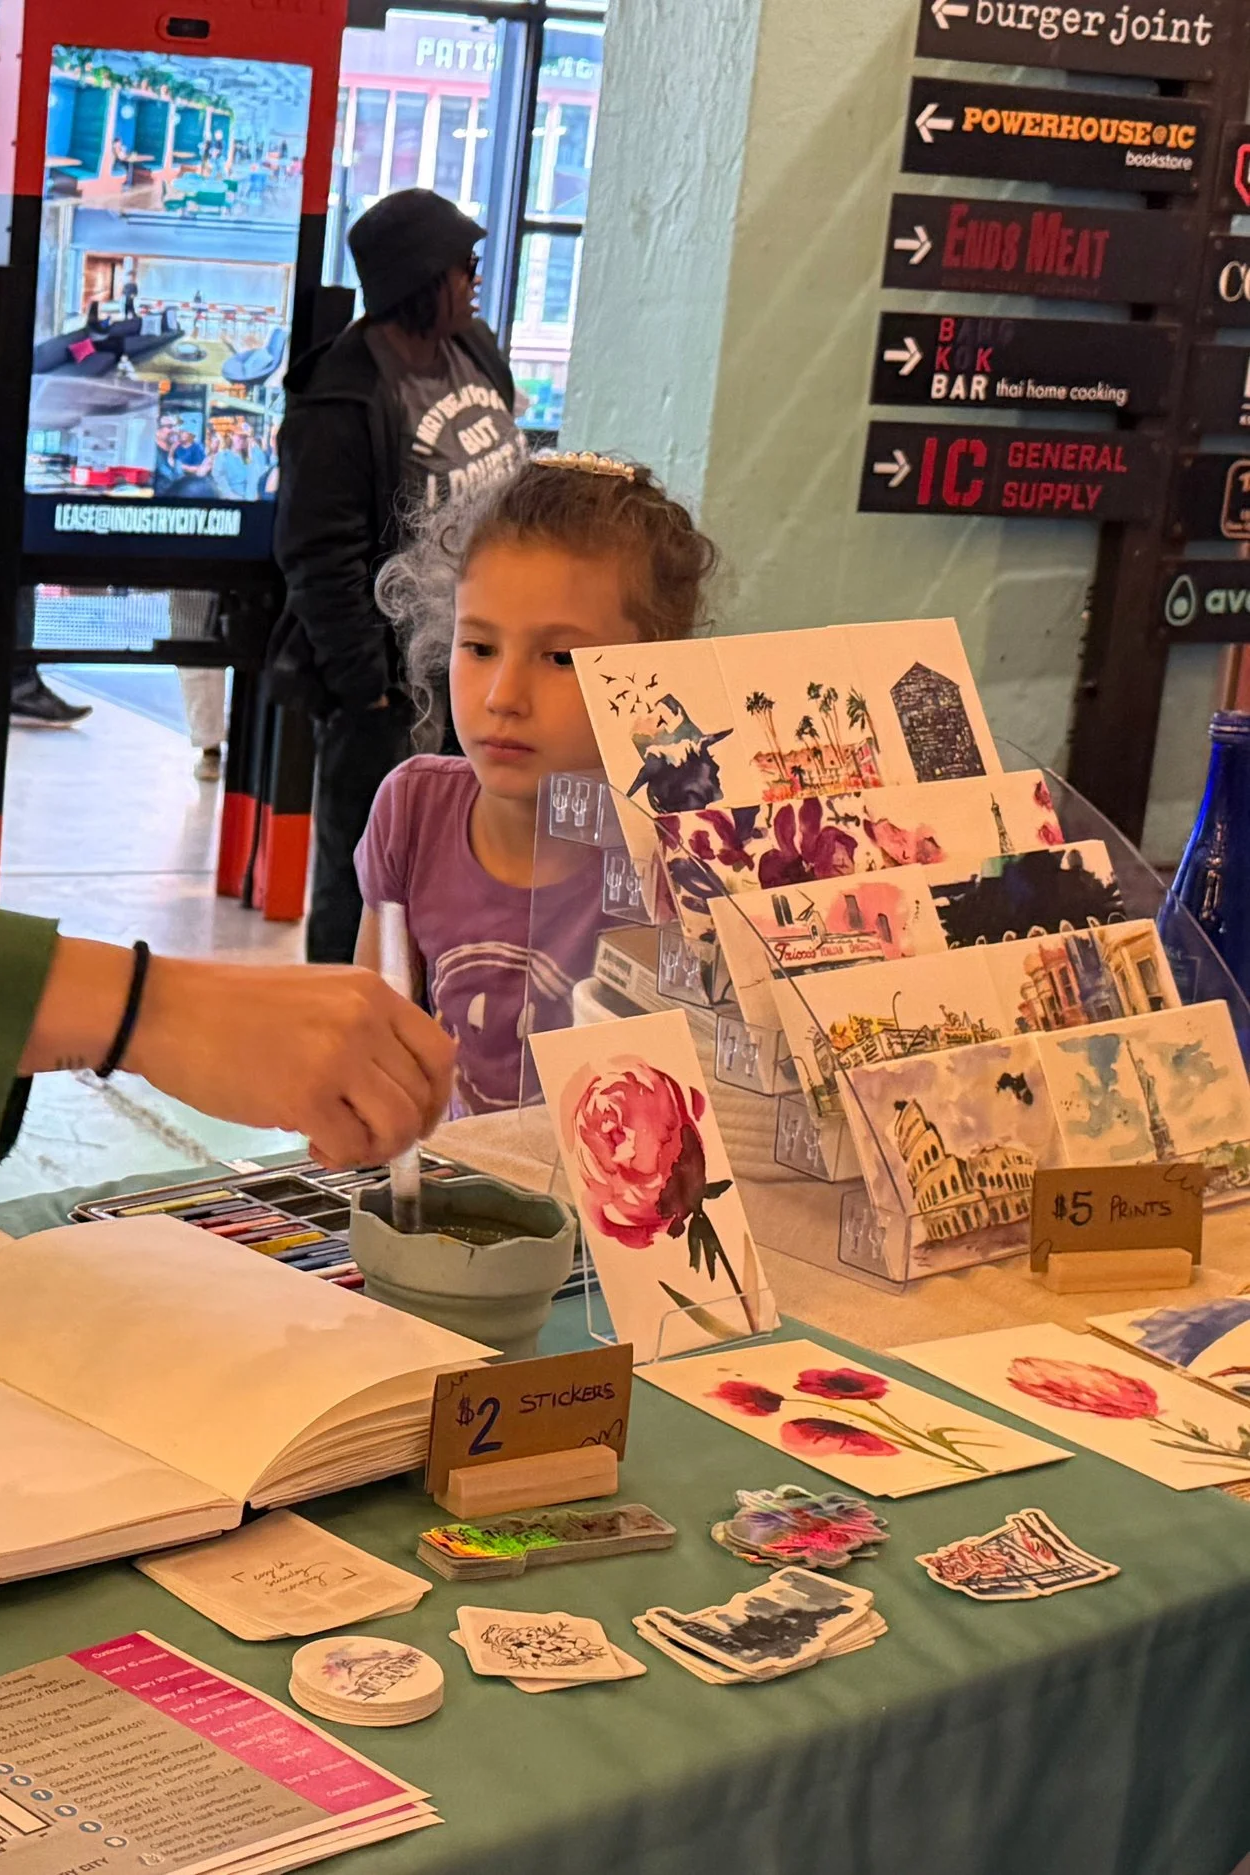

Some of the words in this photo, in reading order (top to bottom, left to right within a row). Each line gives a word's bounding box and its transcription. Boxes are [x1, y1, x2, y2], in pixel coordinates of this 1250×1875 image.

[976, 0, 1104, 38] burger
[1110, 6, 1214, 46] joint
[1125, 150, 1193, 171] bookstore
[930, 373, 989, 400] BAR
[996, 379, 1024, 399] thai
[1025, 379, 1067, 400] home
[1069, 385, 1128, 407] cooking
[916, 437, 987, 507] IC
[1006, 441, 1128, 472] GENERAL
[1001, 481, 1103, 511] SUPPLY
[54, 502, 243, 537] LEASE@INDUSTRYCITY.COM
[518, 1382, 617, 1413] STICKERS
[77, 1855, 111, 1874] CITY
